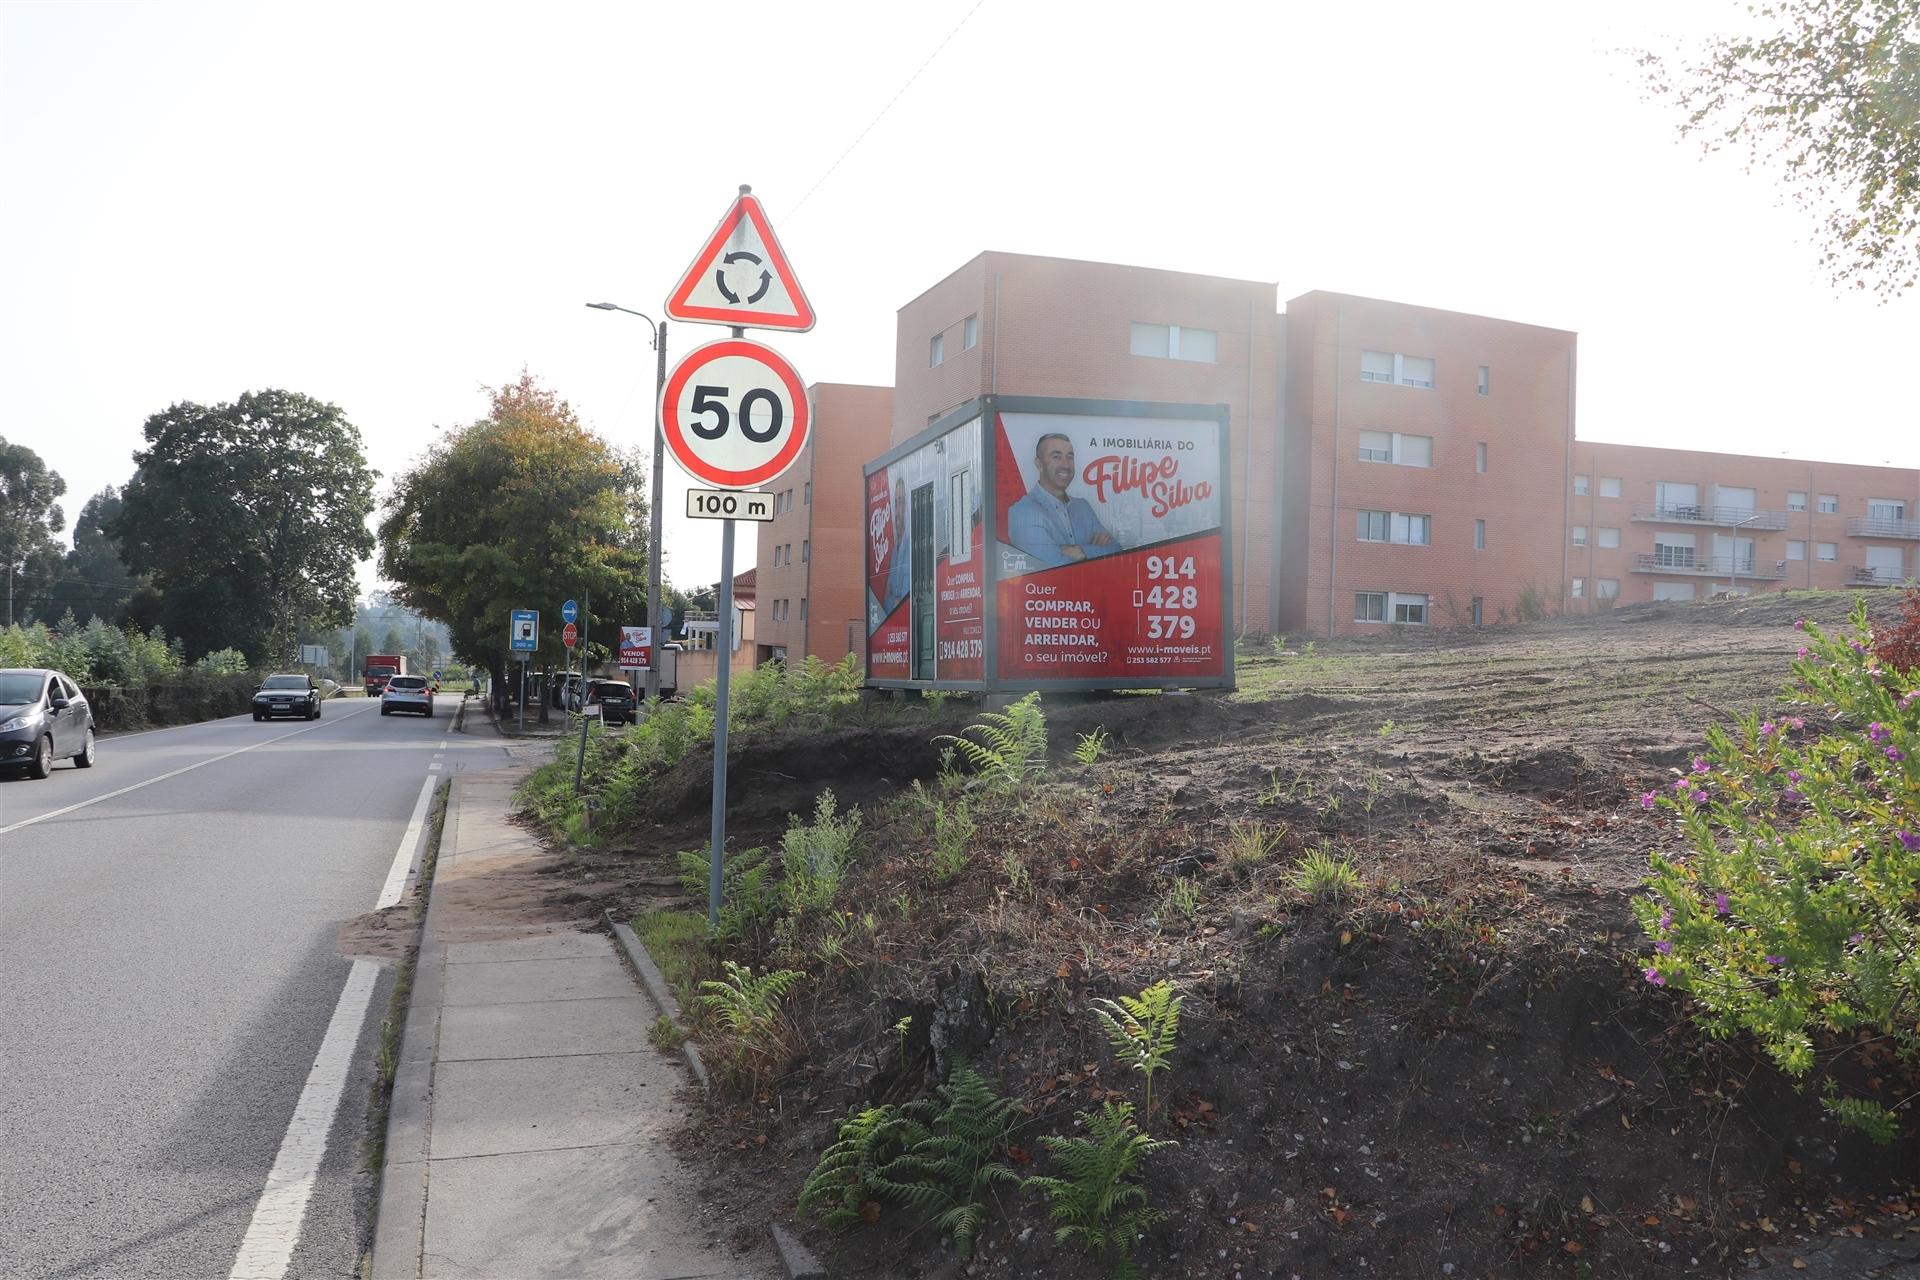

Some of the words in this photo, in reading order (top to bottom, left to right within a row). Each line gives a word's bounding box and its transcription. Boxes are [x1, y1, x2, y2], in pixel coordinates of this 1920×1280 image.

[691, 385, 783, 443] 50
[1090, 438, 1097, 447] A
[1103, 437, 1172, 450] IMOBILIÁRIA
[1178, 441, 1194, 450] DO
[1082, 455, 1178, 503] Filipe
[696, 496, 737, 515] 100
[749, 501, 766, 515] m
[1151, 479, 1212, 518] Silva
[1146, 555, 1197, 580] 914
[1025, 583, 1057, 595] Quer
[1146, 585, 1198, 609] 428
[1025, 600, 1095, 614] COMPRAR,
[1024, 616, 1078, 629] VENDER
[1081, 618, 1101, 630] OU
[1147, 615, 1196, 639] 379
[564, 631, 576, 639] STOP
[1024, 634, 1099, 648] ARRENDAR,
[944, 641, 955, 659] 914
[956, 640, 968, 658] 428
[970, 639, 983, 659] 379
[1024, 653, 1033, 662] o
[1036, 653, 1057, 662] seu
[1061, 651, 1108, 663] imóvel?
[1127, 644, 1211, 656] www.i-moveis.pt
